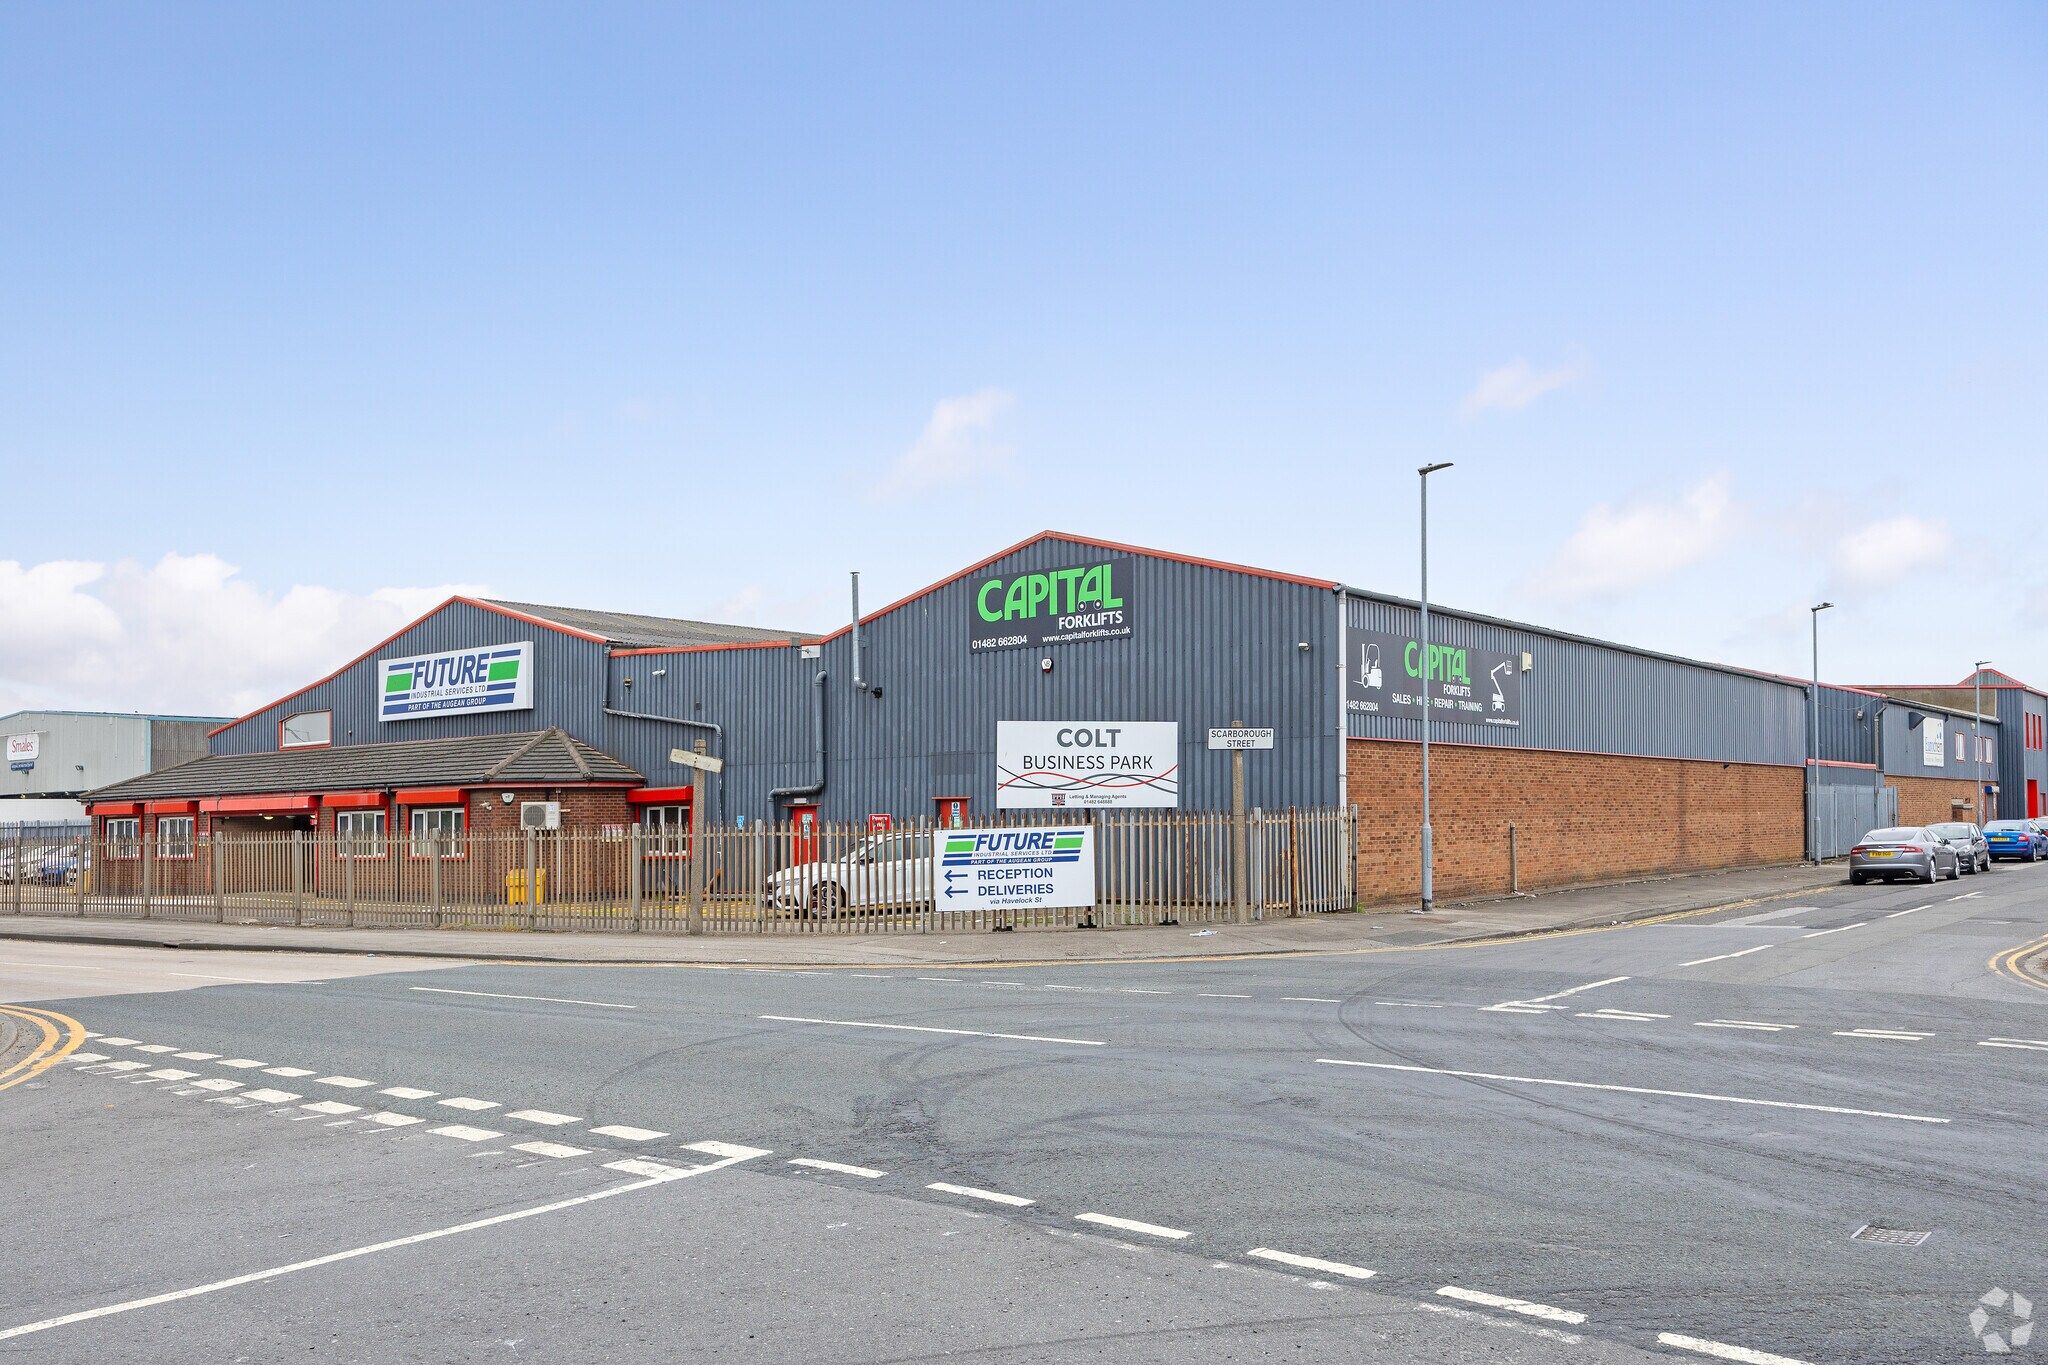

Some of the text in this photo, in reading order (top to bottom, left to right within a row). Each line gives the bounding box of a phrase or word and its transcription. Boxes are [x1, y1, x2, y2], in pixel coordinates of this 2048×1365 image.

[978, 564, 1123, 622] CAPITAL
[1058, 610, 1123, 629] FORKLIFTS
[972, 635, 1028, 649] 01482 662804
[1042, 626, 1131, 643] www.capitalforklifts.co.uk
[412, 653, 490, 689] FUTURE
[411, 685, 486, 700] INDUSTRIAL SERVICES LTD
[1443, 684, 1471, 697] FORKLIFTS
[408, 697, 486, 711] PART OF THE AUGEAN GROUP
[1347, 701, 1378, 712] 1482 662804
[1392, 693, 1482, 712] SALES HIE REPAIR TRAINING
[12, 738, 33, 753] Smales
[1057, 728, 1121, 748] COLT
[1024, 755, 1153, 770] BUSINESS PARK
[975, 832, 1055, 851] FUTURE
[978, 868, 1053, 880] RECEPTION
[978, 884, 1054, 896] DELIVERIES
